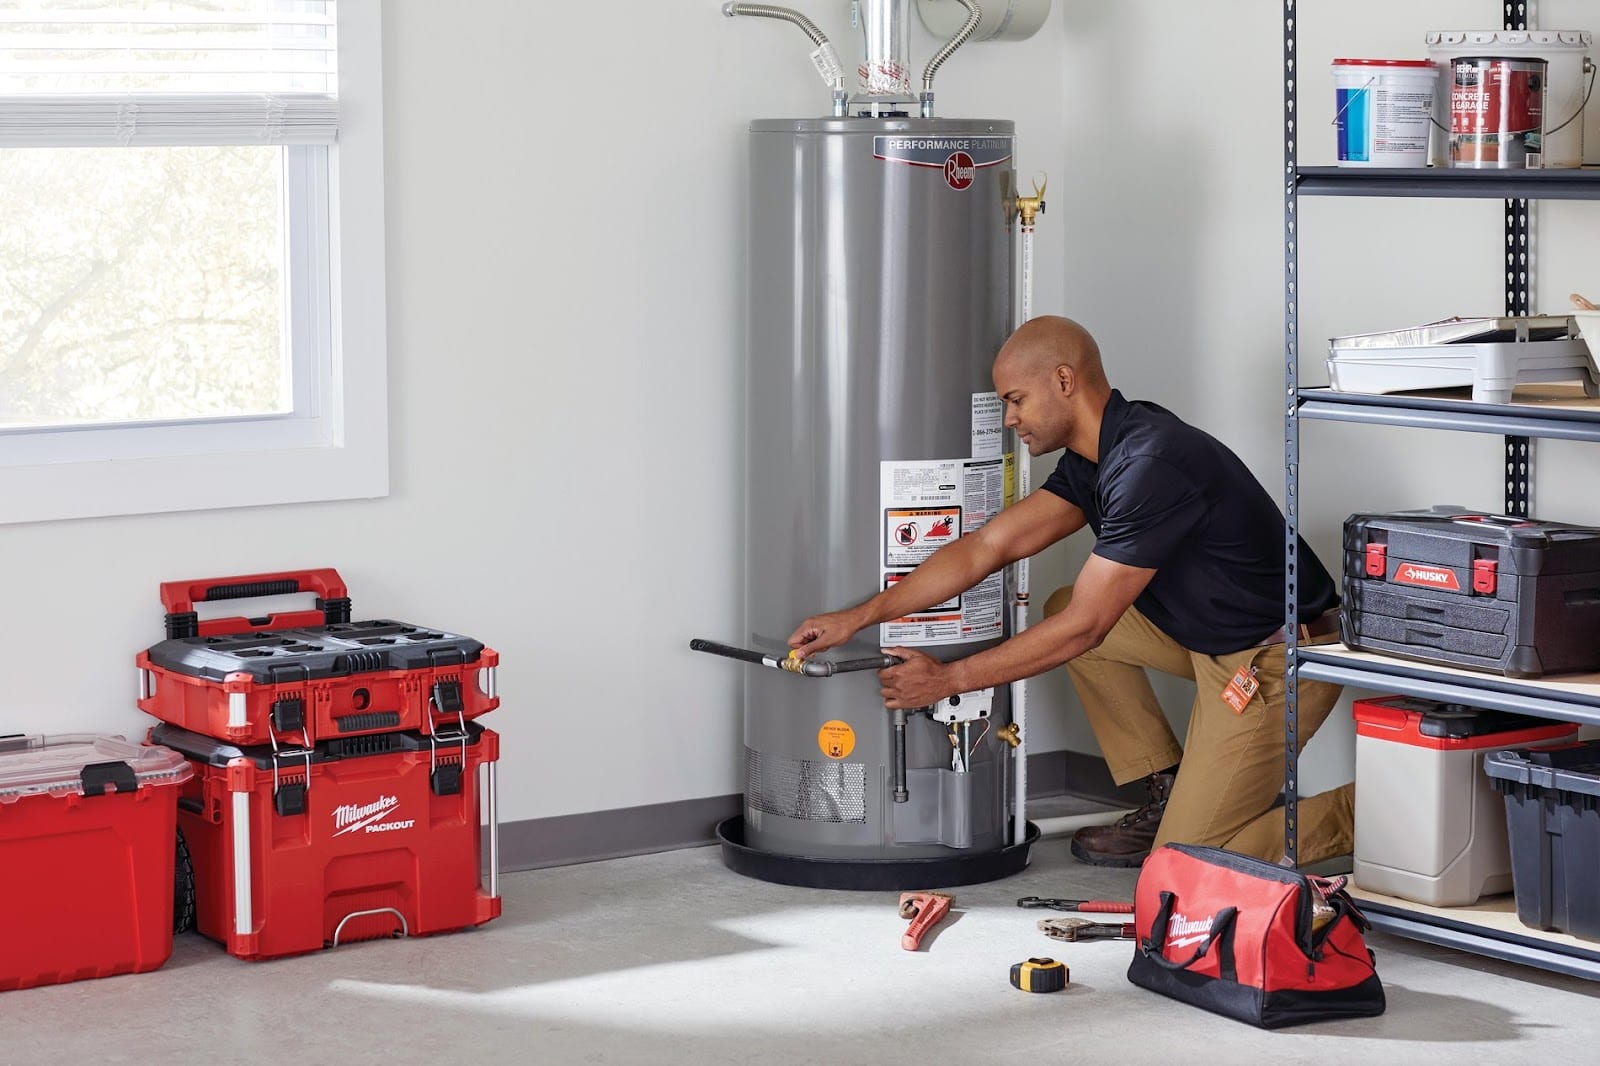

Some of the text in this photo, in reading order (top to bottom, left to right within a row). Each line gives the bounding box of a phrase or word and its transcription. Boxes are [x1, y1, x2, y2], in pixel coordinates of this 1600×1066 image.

[1456, 64, 1473, 73] BEHR
[889, 139, 1007, 150] PERFORMANCE PLATINUM
[947, 152, 974, 185] Rheem
[1415, 570, 1448, 583] HUSKY
[331, 795, 399, 829] Milwaukee
[365, 820, 415, 833] PACKOUT
[1169, 912, 1214, 938] Milwauk
